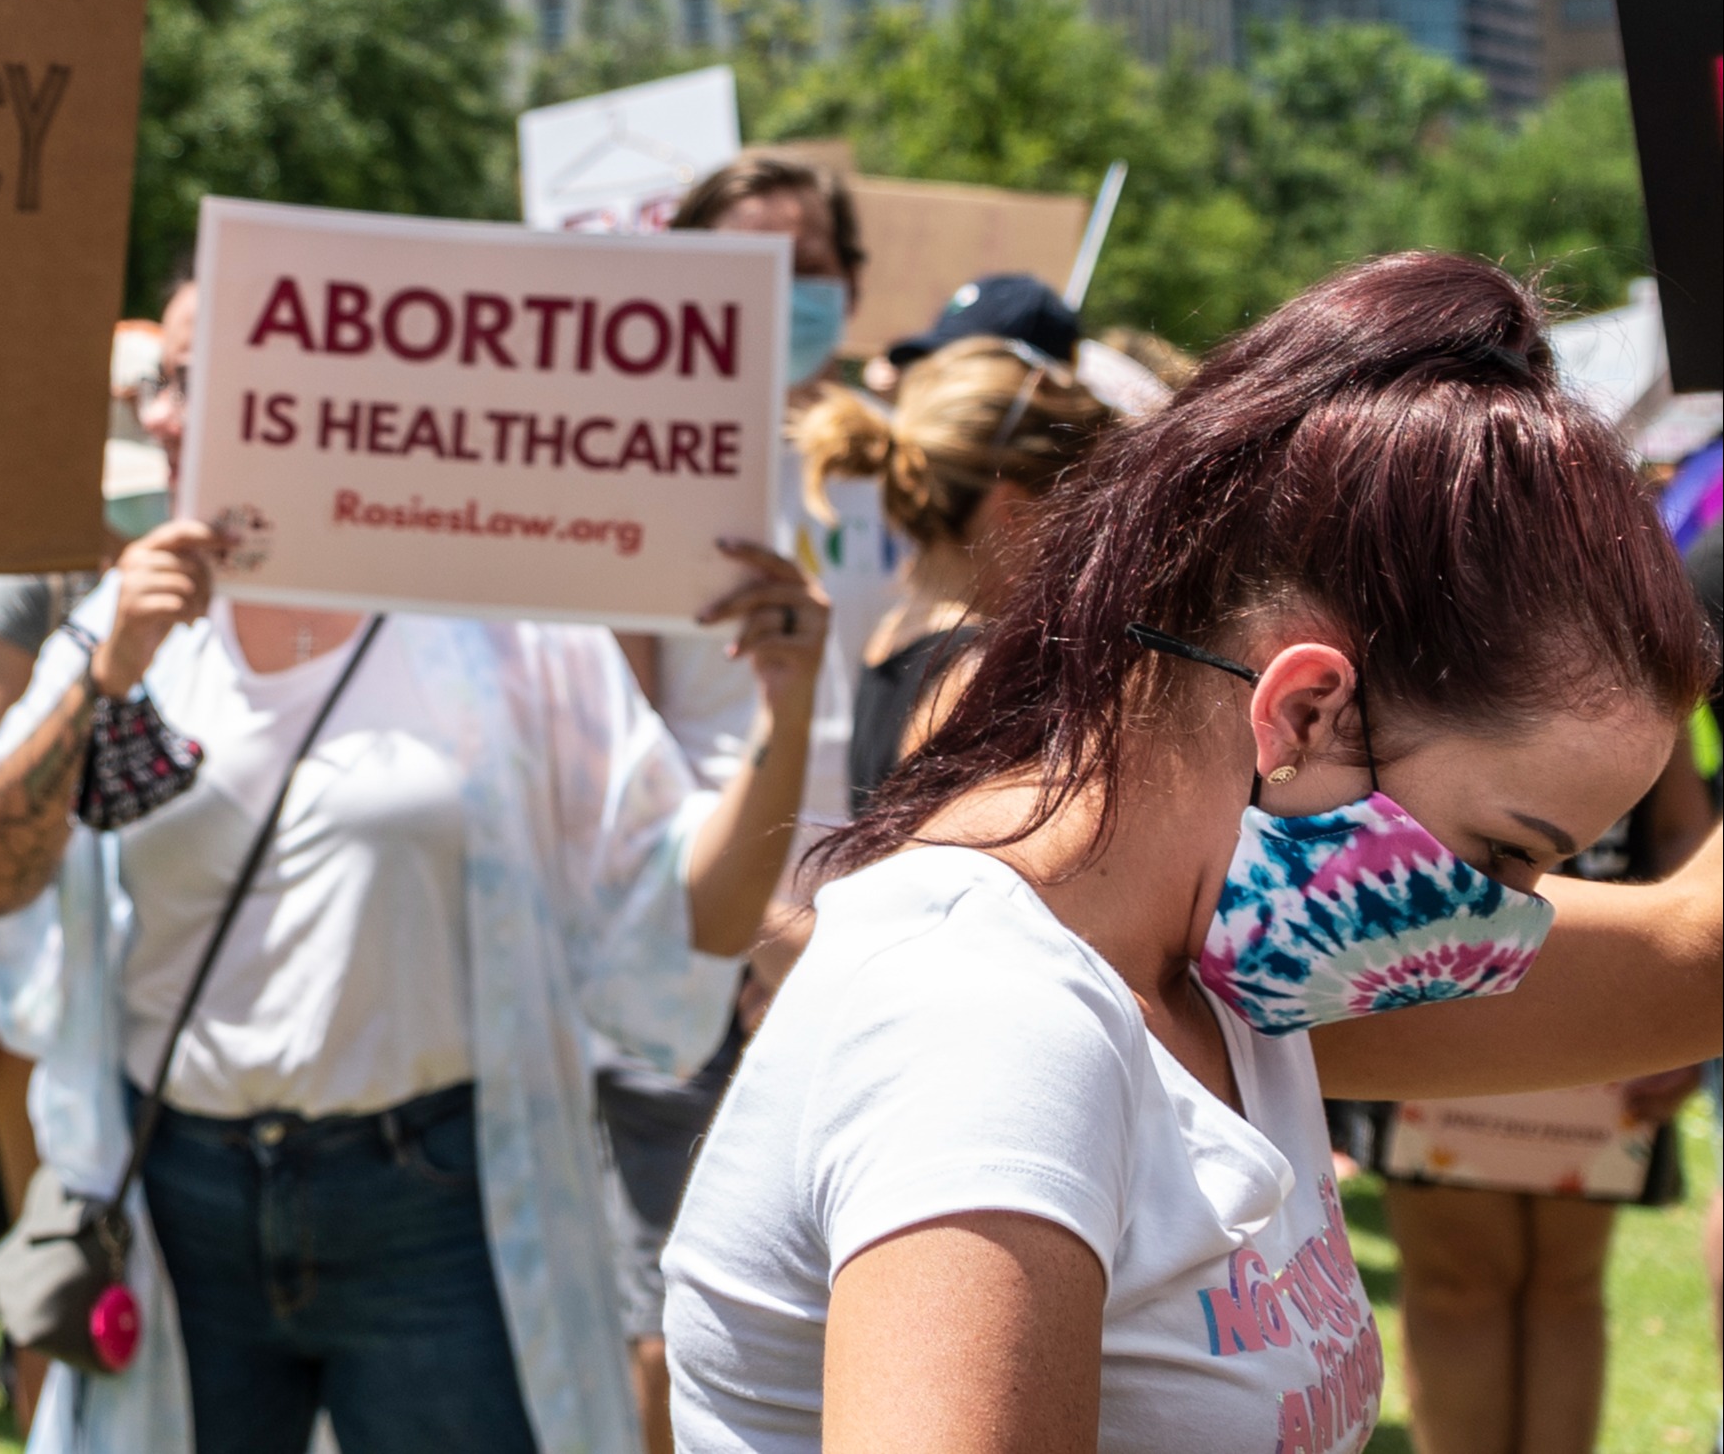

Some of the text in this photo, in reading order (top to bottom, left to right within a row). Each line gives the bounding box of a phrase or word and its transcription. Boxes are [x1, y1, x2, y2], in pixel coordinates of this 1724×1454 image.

[247, 276, 742, 378] ABORTION
[241, 391, 742, 476] IS HEALTHCARE
[332, 489, 644, 555] RosiesLaw.org
